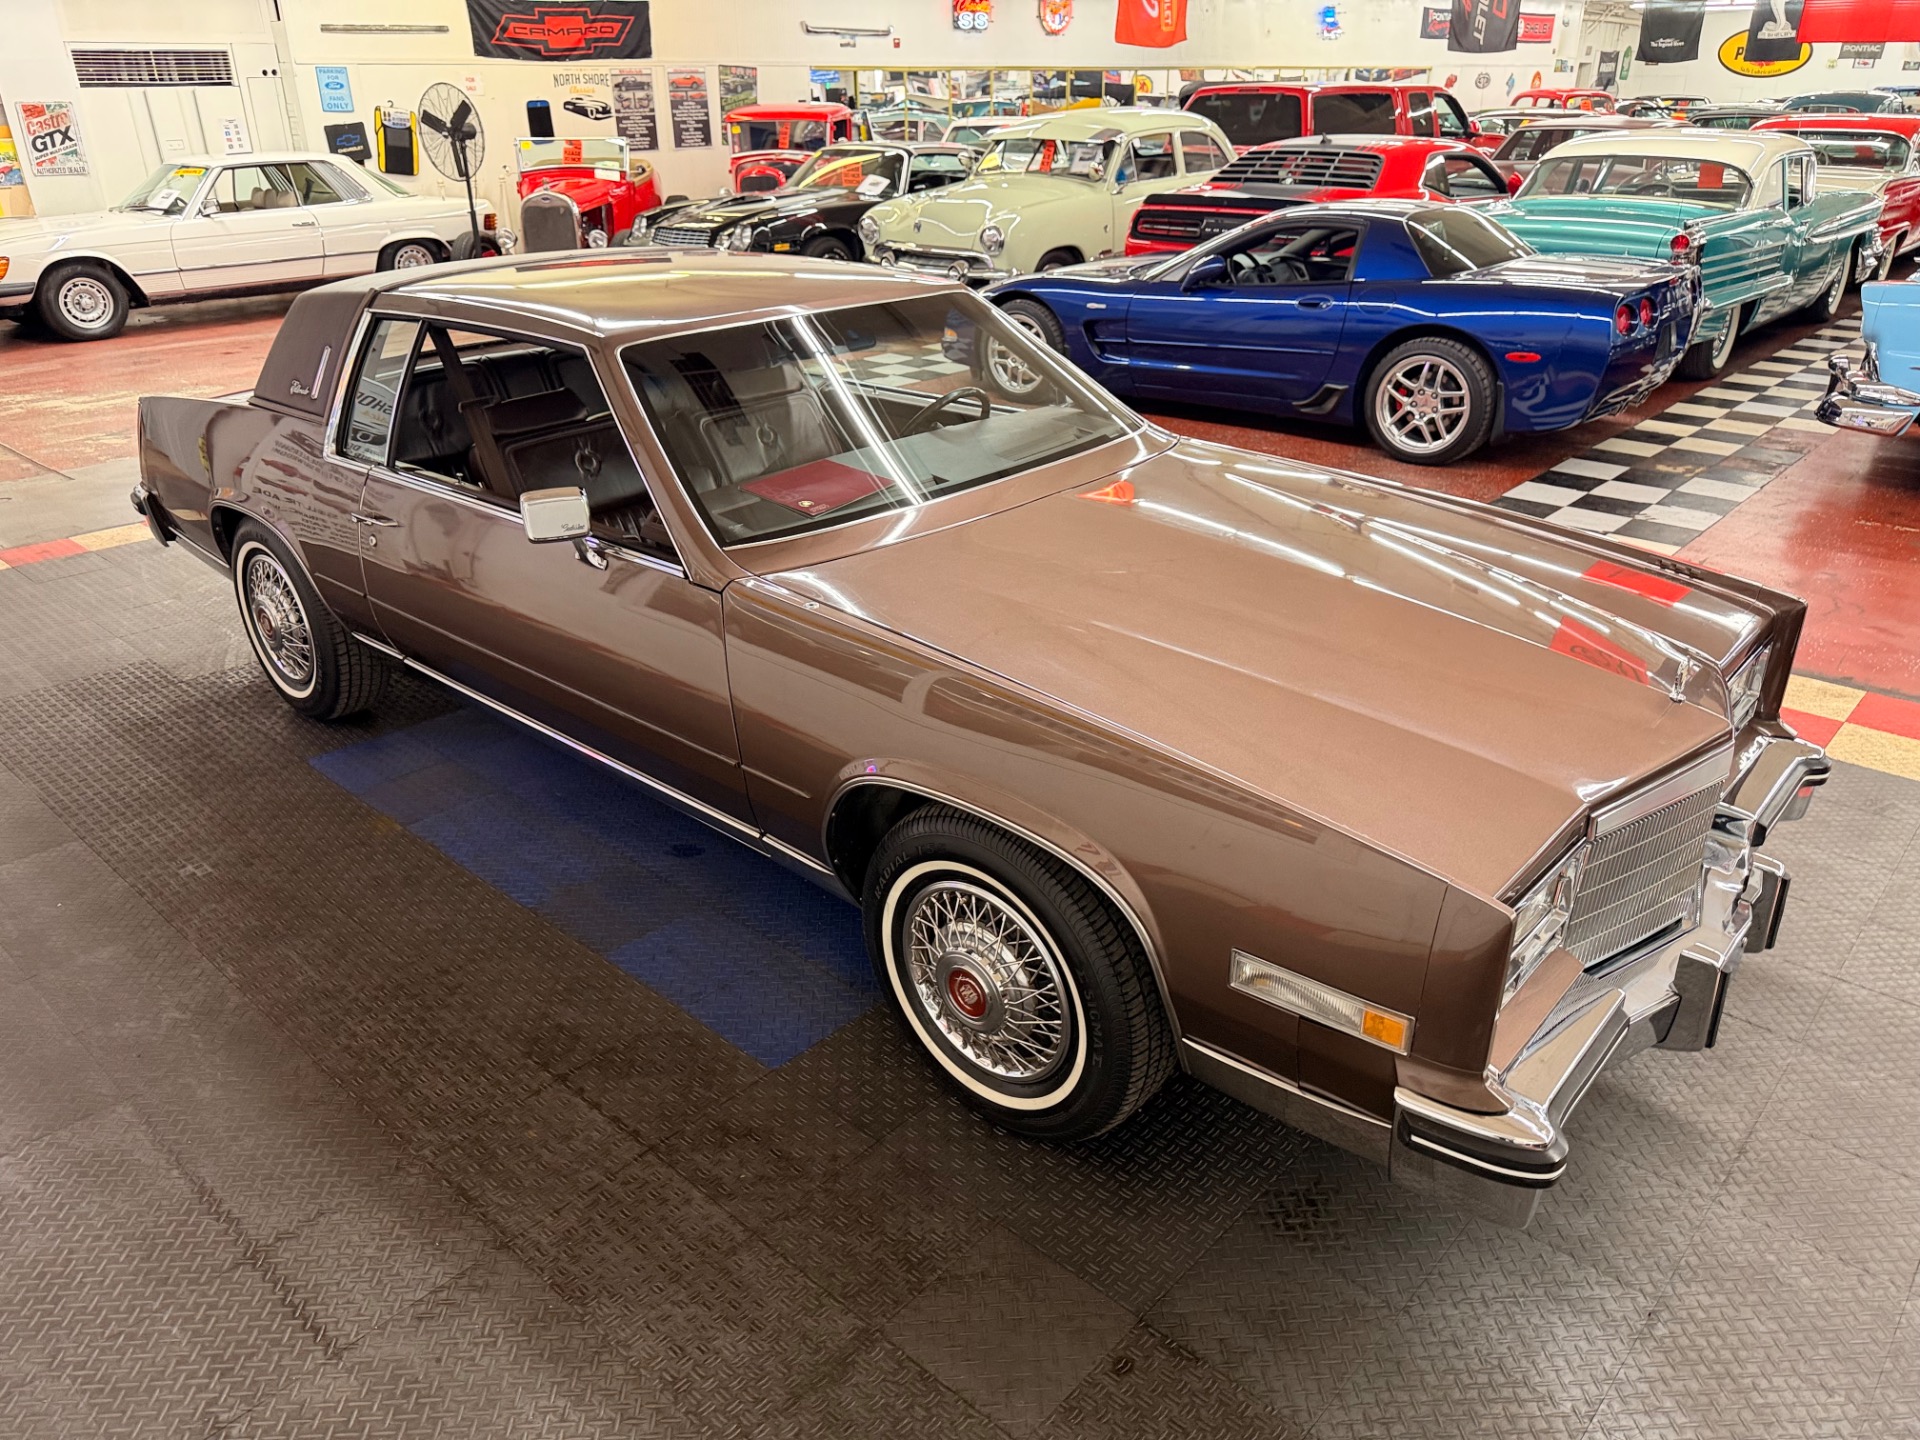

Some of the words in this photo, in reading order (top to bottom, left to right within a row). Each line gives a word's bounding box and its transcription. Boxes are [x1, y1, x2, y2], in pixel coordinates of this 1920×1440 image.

[958, 12, 988, 30] SS
[513, 25, 615, 37] CAMARO
[553, 73, 581, 88] NORTH
[583, 73, 610, 87] SHORE
[27, 110, 71, 136] Castro
[31, 125, 75, 152] GTX
[35, 152, 49, 160] SUPER
[36, 167, 66, 175] AUTHORIZED
[67, 166, 86, 174] DEALER
[874, 851, 911, 900] RADIAL
[1084, 990, 1104, 1049] SIGMA
